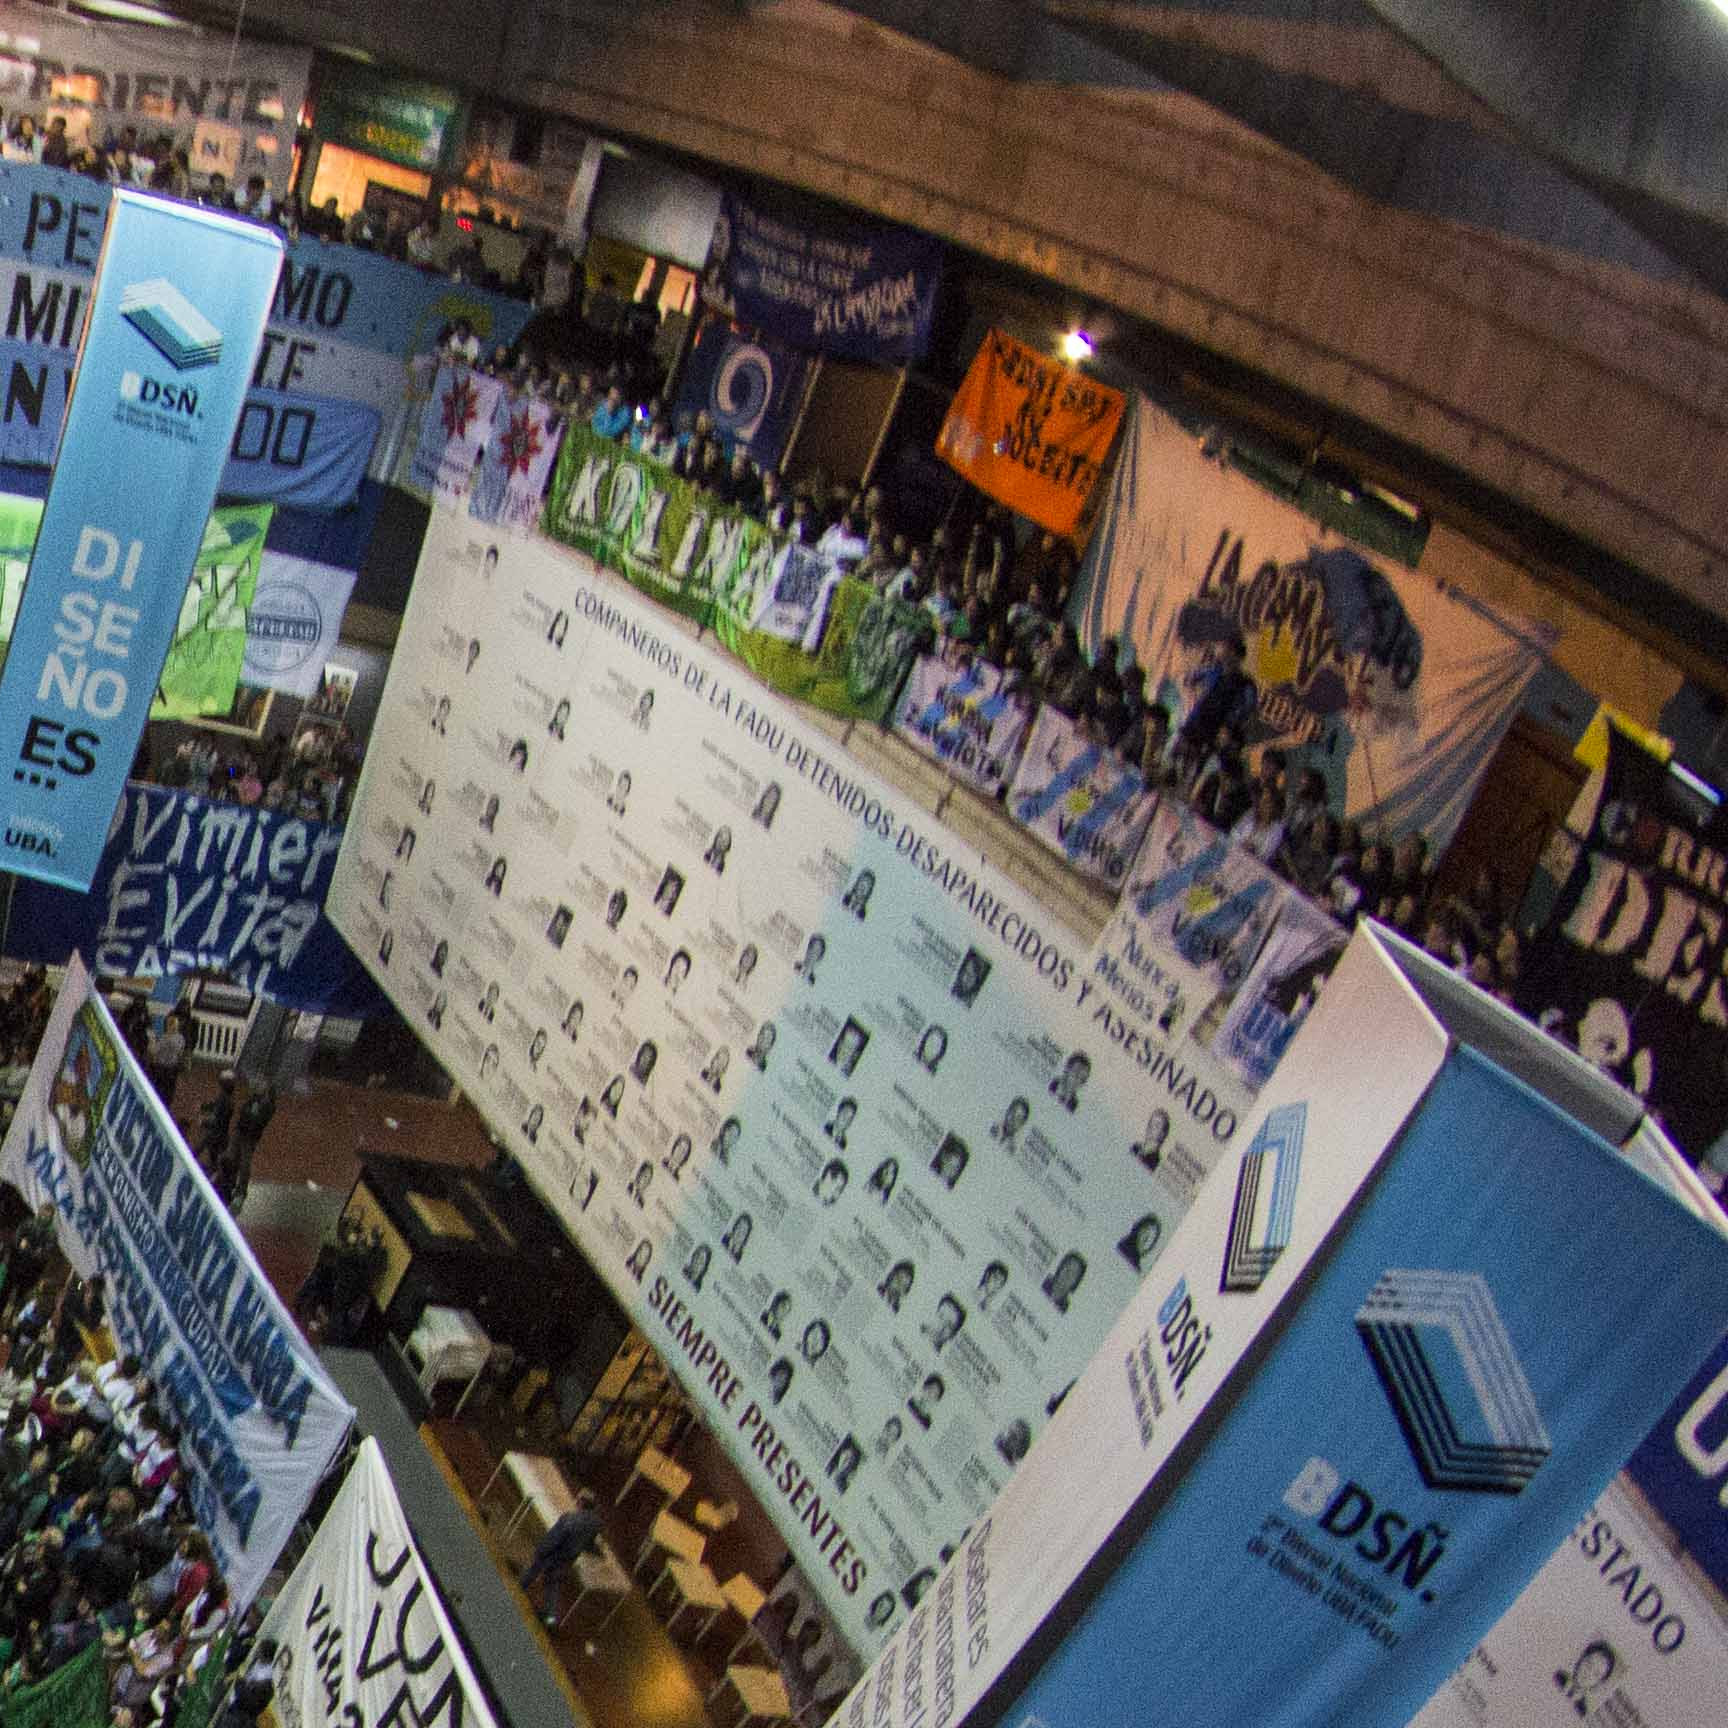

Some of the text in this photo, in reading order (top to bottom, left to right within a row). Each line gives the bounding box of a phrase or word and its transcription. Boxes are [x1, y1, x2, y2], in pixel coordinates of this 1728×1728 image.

[684, 660, 715, 697] DE
[709, 680, 736, 715] LA
[737, 696, 784, 751] FADU
[100, 860, 318, 971] Evita
[646, 1275, 869, 1594] SIEMPRE PRESENTES
